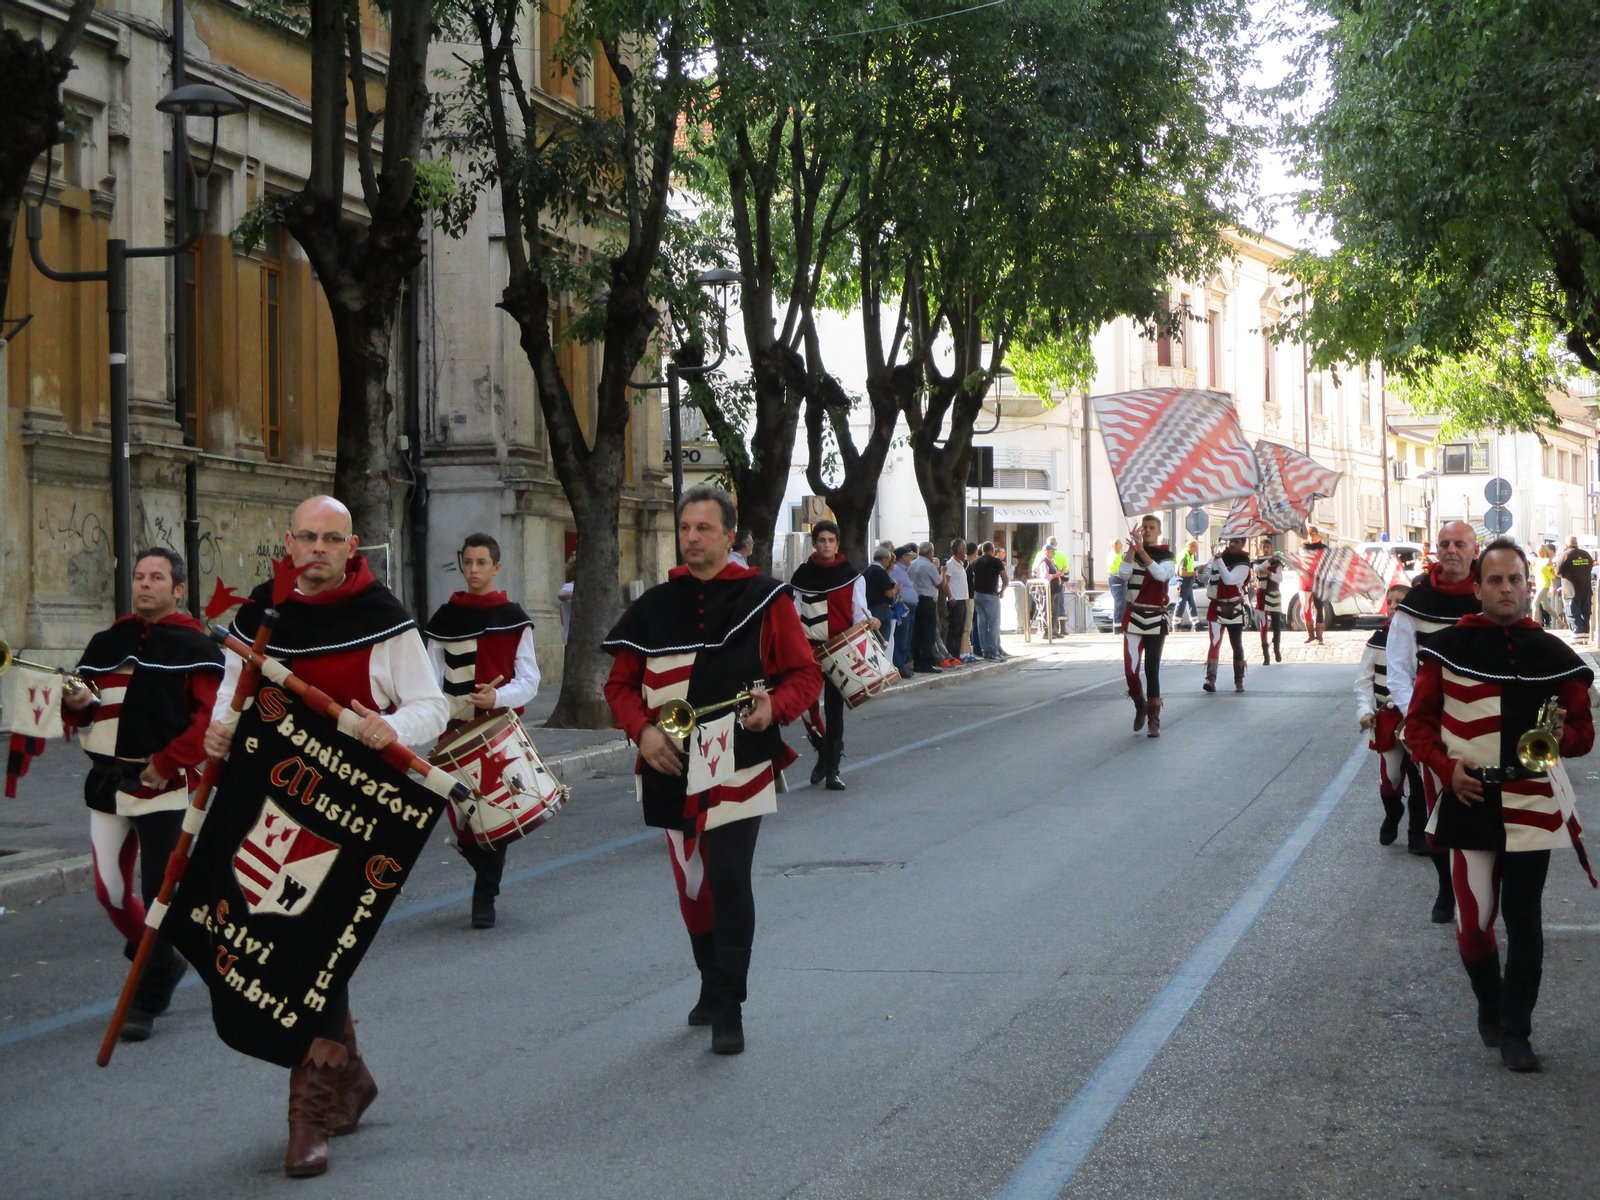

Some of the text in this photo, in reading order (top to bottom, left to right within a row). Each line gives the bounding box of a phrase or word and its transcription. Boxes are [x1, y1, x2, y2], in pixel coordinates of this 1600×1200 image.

[246, 736, 378, 841] e Musici
[256, 686, 433, 829] Sbandieratori
[215, 945, 298, 1028] Umbria
[303, 854, 401, 1012] Carbium
